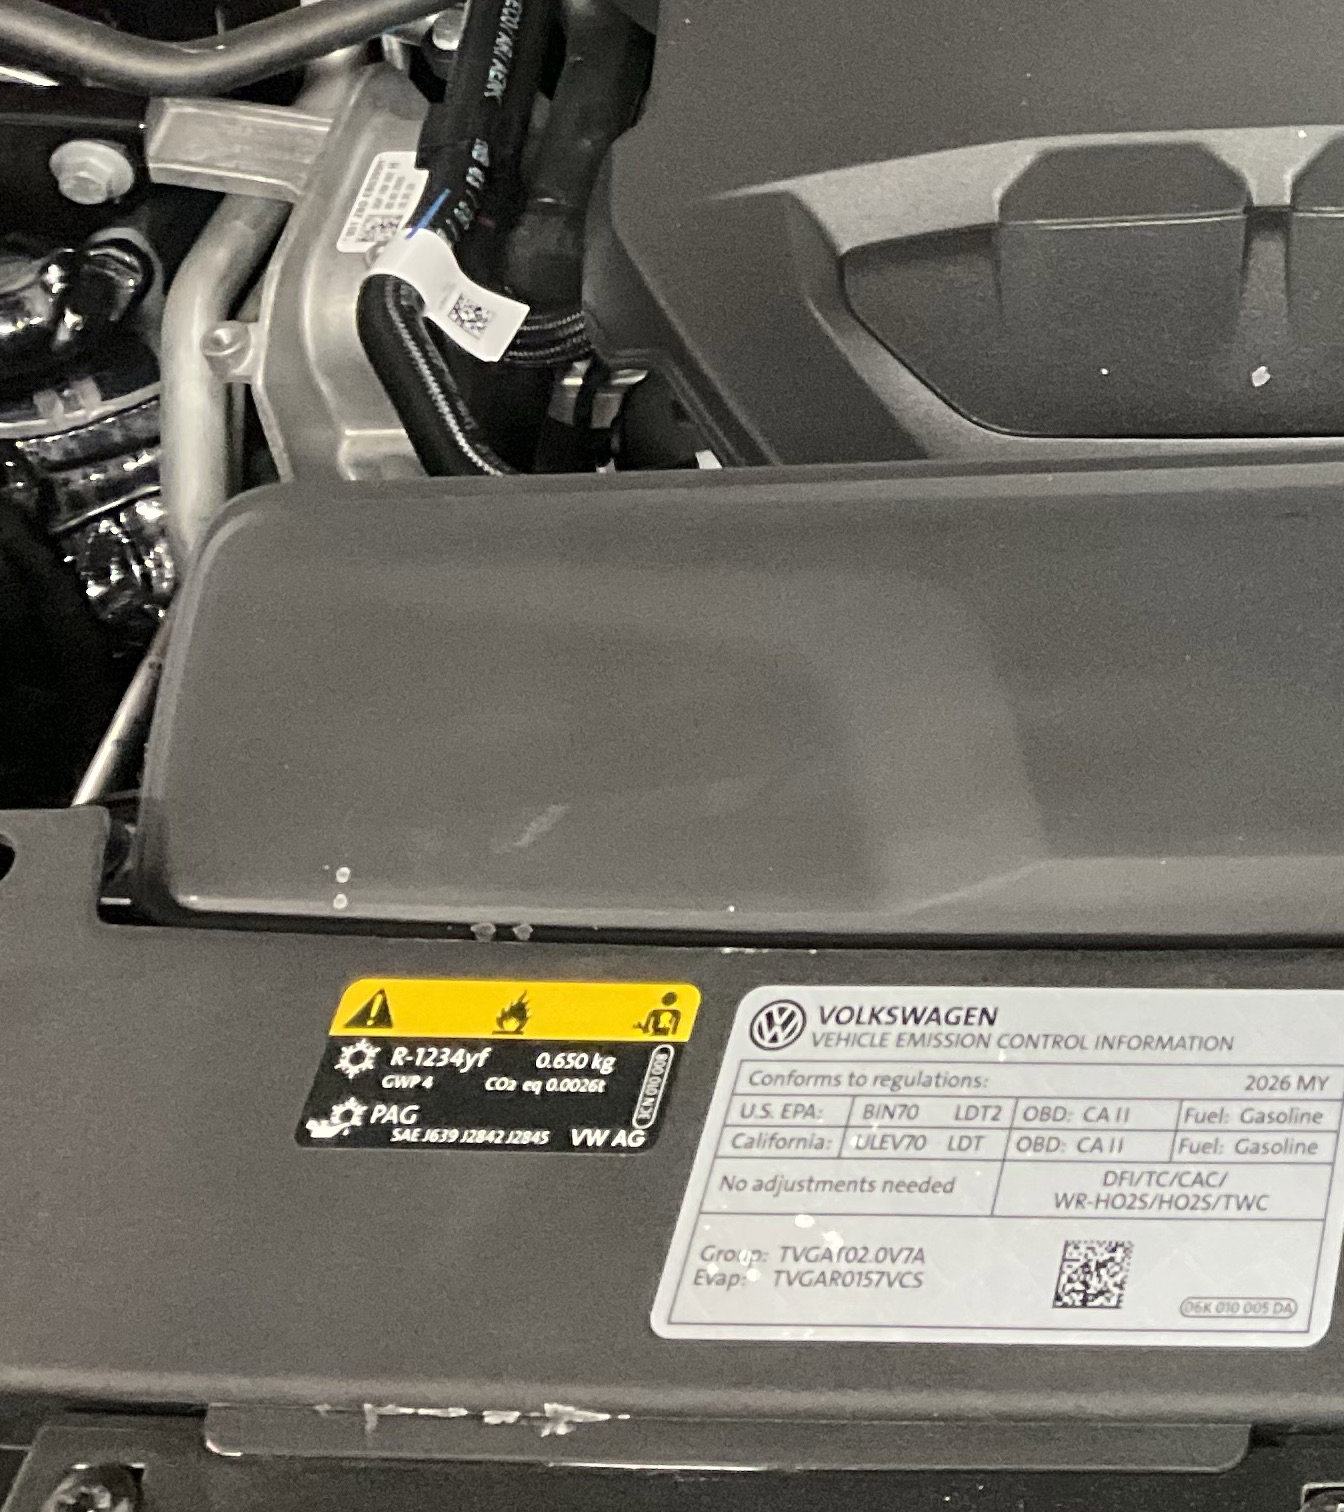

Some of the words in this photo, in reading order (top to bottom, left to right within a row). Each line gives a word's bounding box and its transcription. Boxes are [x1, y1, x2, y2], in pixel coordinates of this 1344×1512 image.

[819, 1005, 999, 1027] VOLKSWAGEN
[812, 1032, 889, 1048] VEHICLE
[896, 1033, 991, 1049] EMISSION
[997, 1034, 1088, 1050] CONTROL
[1094, 1034, 1234, 1052] INFORMATION
[390, 1047, 493, 1073] R-1234yf
[535, 1052, 589, 1069] 0.650
[591, 1053, 617, 1075] kg
[381, 1074, 421, 1089] GWP
[422, 1076, 434, 1089] 4
[522, 1079, 543, 1096] eq
[545, 1078, 606, 1093] 0.0026t
[749, 1070, 842, 1088] Conforms
[848, 1071, 867, 1087] to
[872, 1071, 989, 1092] regulations:
[1245, 1075, 1291, 1092] 2026
[1297, 1076, 1330, 1091] MY
[369, 1104, 420, 1125] PAG
[740, 1104, 774, 1119] U.S.
[781, 1104, 823, 1119] EPA:
[863, 1104, 919, 1120] BIN70
[955, 1105, 1001, 1121] LDT2
[1023, 1106, 1074, 1123] OBD:
[1083, 1106, 1111, 1123] CA
[1184, 1108, 1229, 1125] Fuel:
[1240, 1108, 1324, 1125] Gasoline
[389, 1128, 422, 1143] SAE
[571, 1128, 611, 1147] VW
[614, 1130, 647, 1148] AG
[731, 1133, 833, 1150] California:
[947, 1135, 985, 1151] LDT
[1016, 1136, 1067, 1154] OBD:
[1077, 1137, 1104, 1154] CA
[1178, 1138, 1224, 1155] Fuel:
[1235, 1138, 1319, 1156] Gasoline
[720, 1176, 748, 1192] No
[753, 1176, 876, 1197] adjustments
[882, 1177, 957, 1194] needed
[1103, 1169, 1229, 1188] DFI/TC/CAC/
[1215, 1302, 1240, 1313] 010
